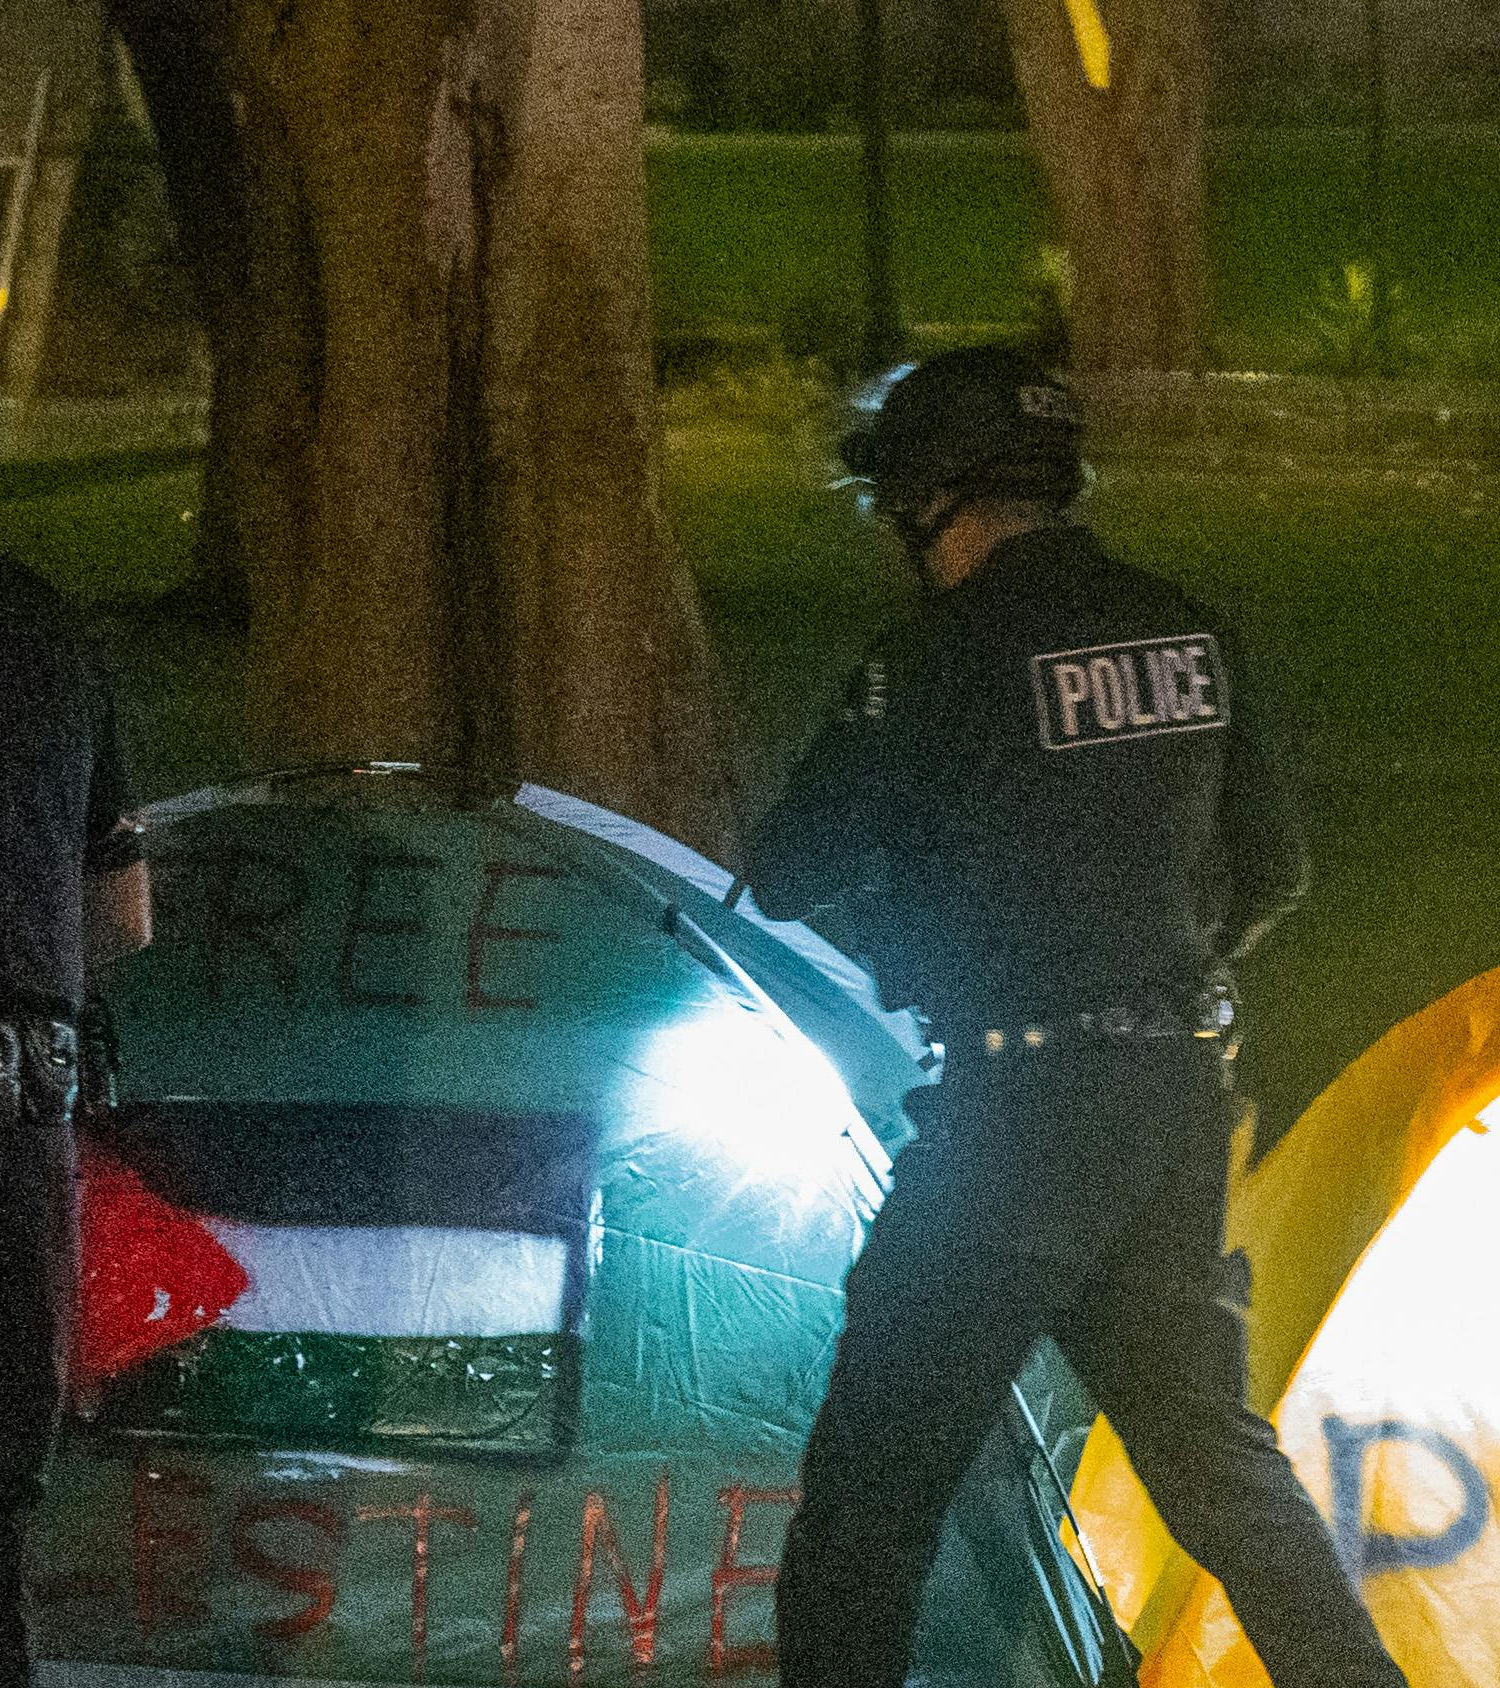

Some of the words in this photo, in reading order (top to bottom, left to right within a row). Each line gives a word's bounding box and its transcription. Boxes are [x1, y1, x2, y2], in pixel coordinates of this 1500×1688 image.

[1051, 645, 1218, 737] POLICE
[152, 842, 566, 1010] REE
[32, 1460, 802, 1688] ESTINE
